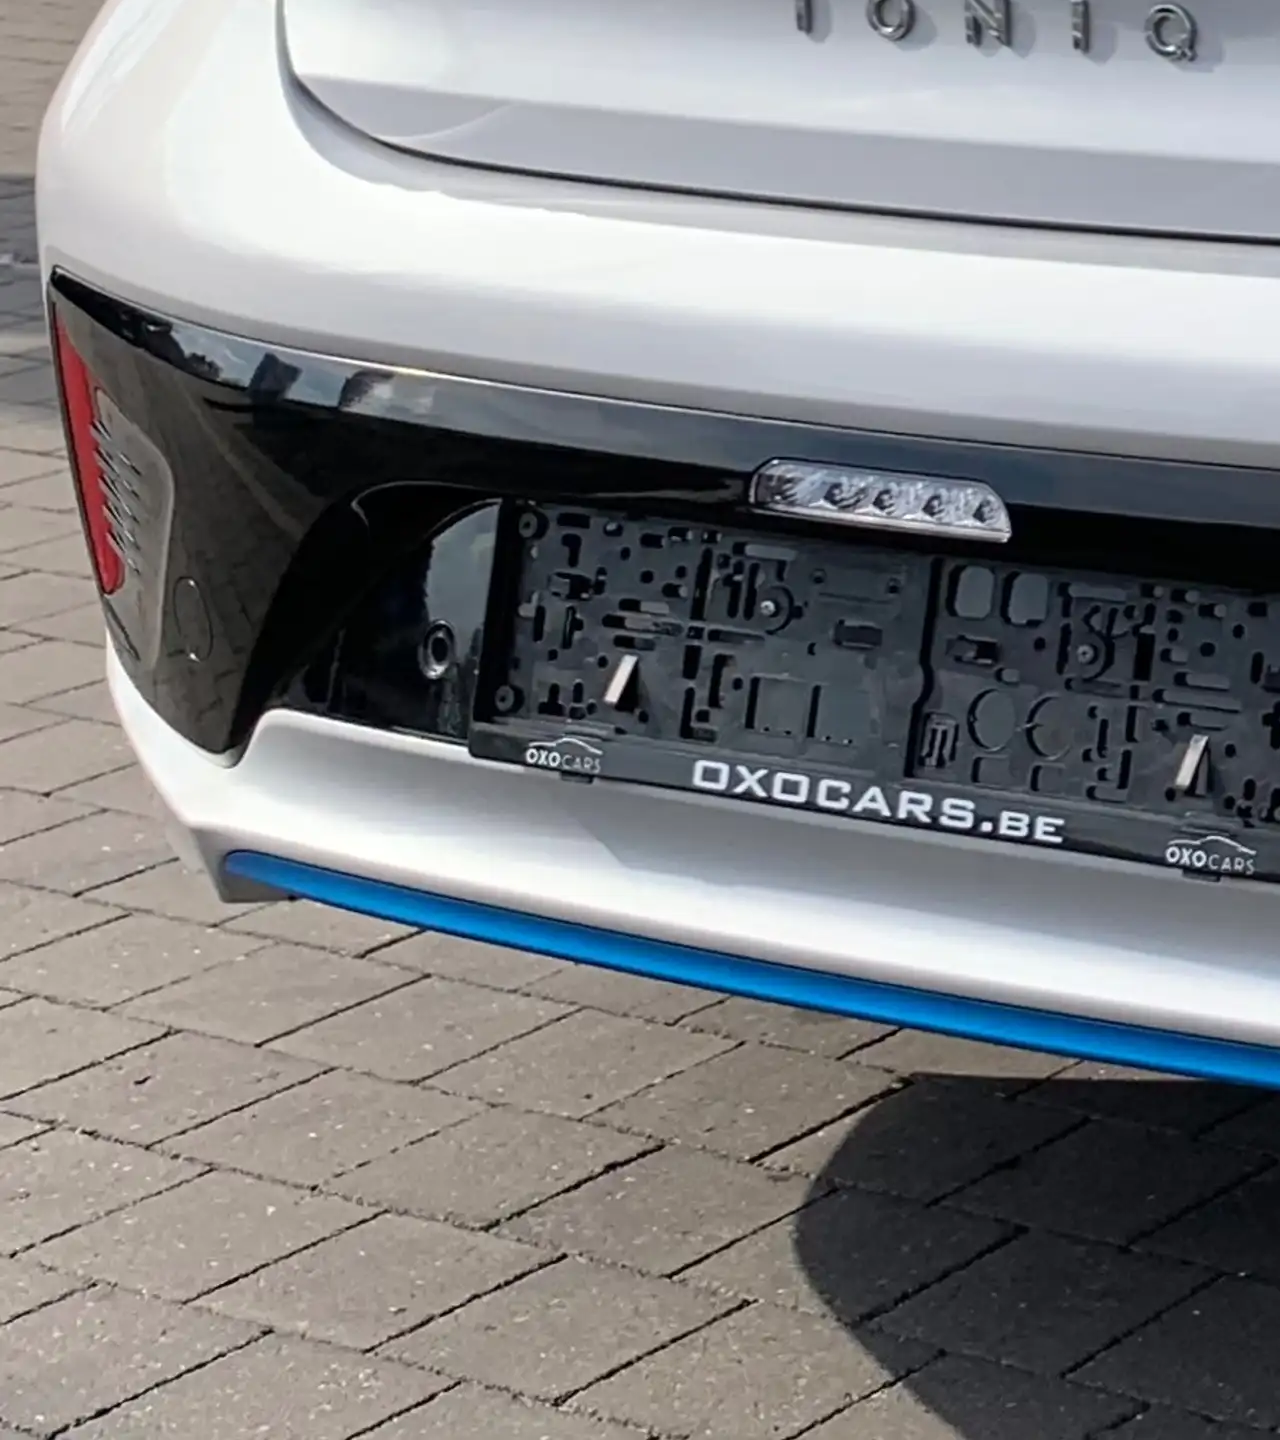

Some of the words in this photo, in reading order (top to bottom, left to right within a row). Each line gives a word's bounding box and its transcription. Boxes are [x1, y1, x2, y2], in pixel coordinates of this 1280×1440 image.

[525, 747, 601, 773] OXOCARS
[692, 759, 1064, 843] OXOCARS.BE
[1165, 846, 1255, 875] OXOCARS
